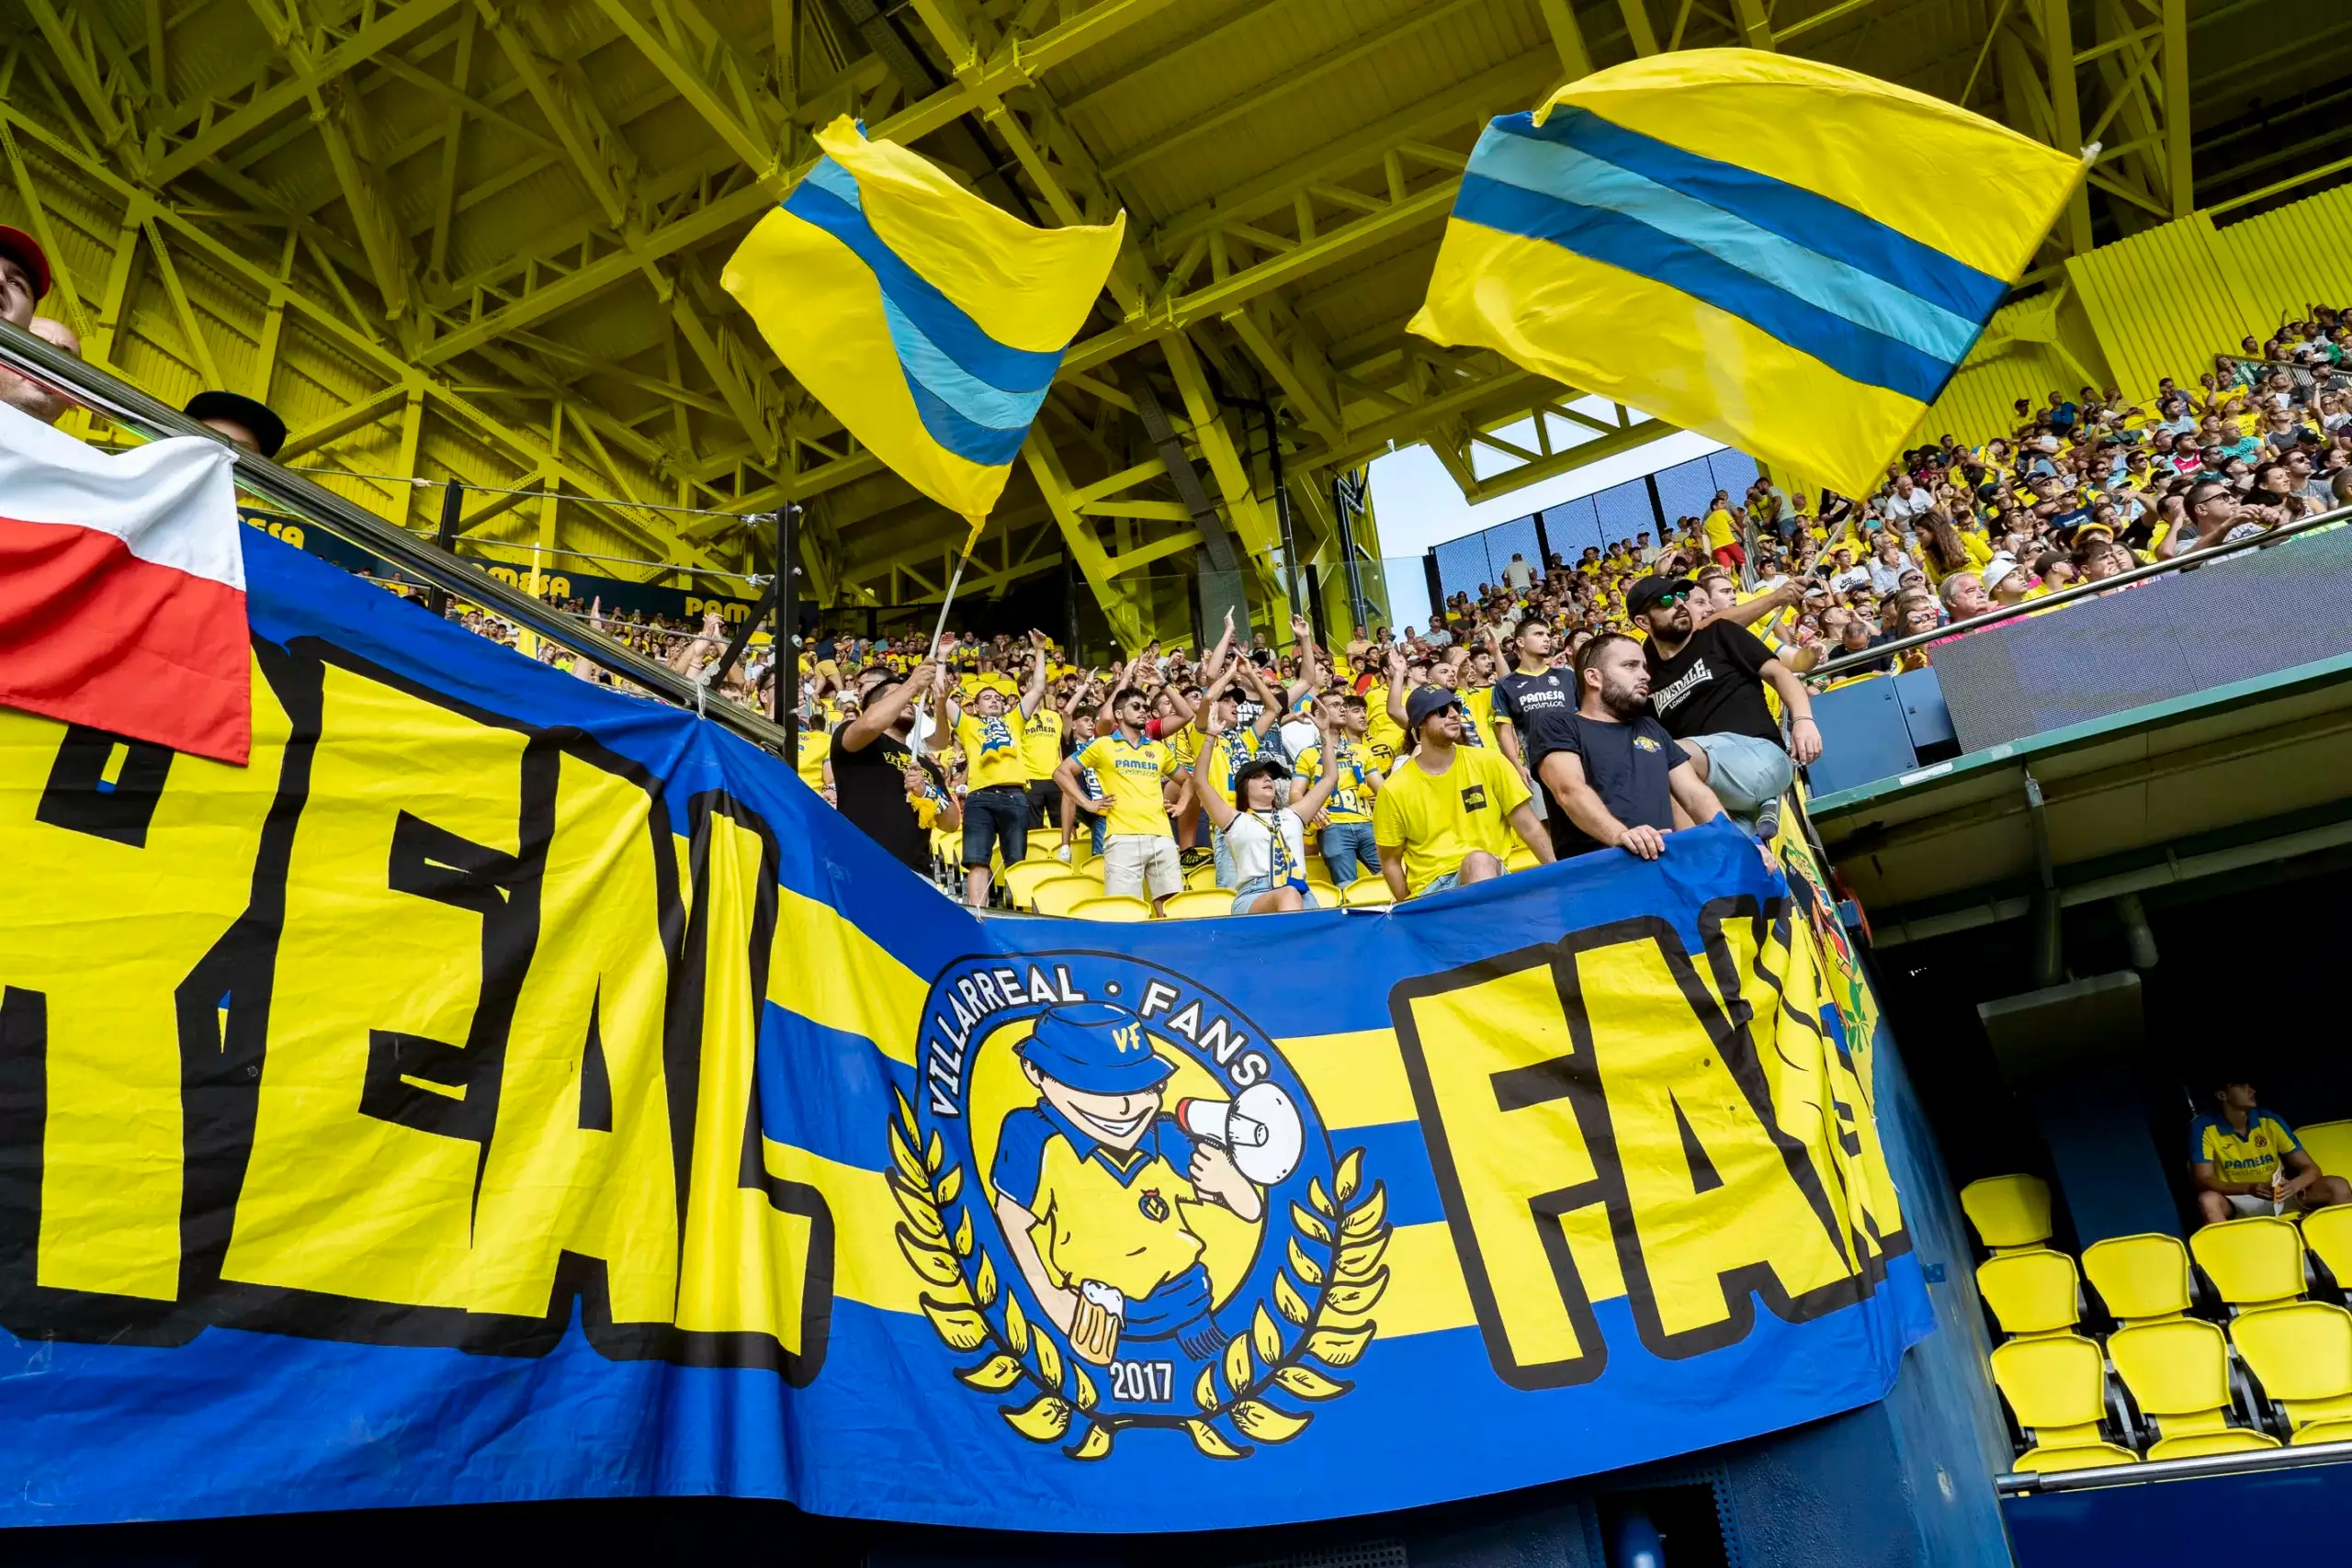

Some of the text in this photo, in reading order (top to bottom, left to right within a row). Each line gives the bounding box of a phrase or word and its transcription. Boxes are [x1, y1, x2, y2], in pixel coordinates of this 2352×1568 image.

[1519, 691, 1565, 705] PAMESA
[1669, 690, 1690, 709] LONDON
[1115, 760, 1159, 771] PAMESA
[928, 965, 1269, 1115] VILLARREAL FANS
[1112, 1021, 1141, 1054] VF
[1109, 1361, 1172, 1401] 2017
